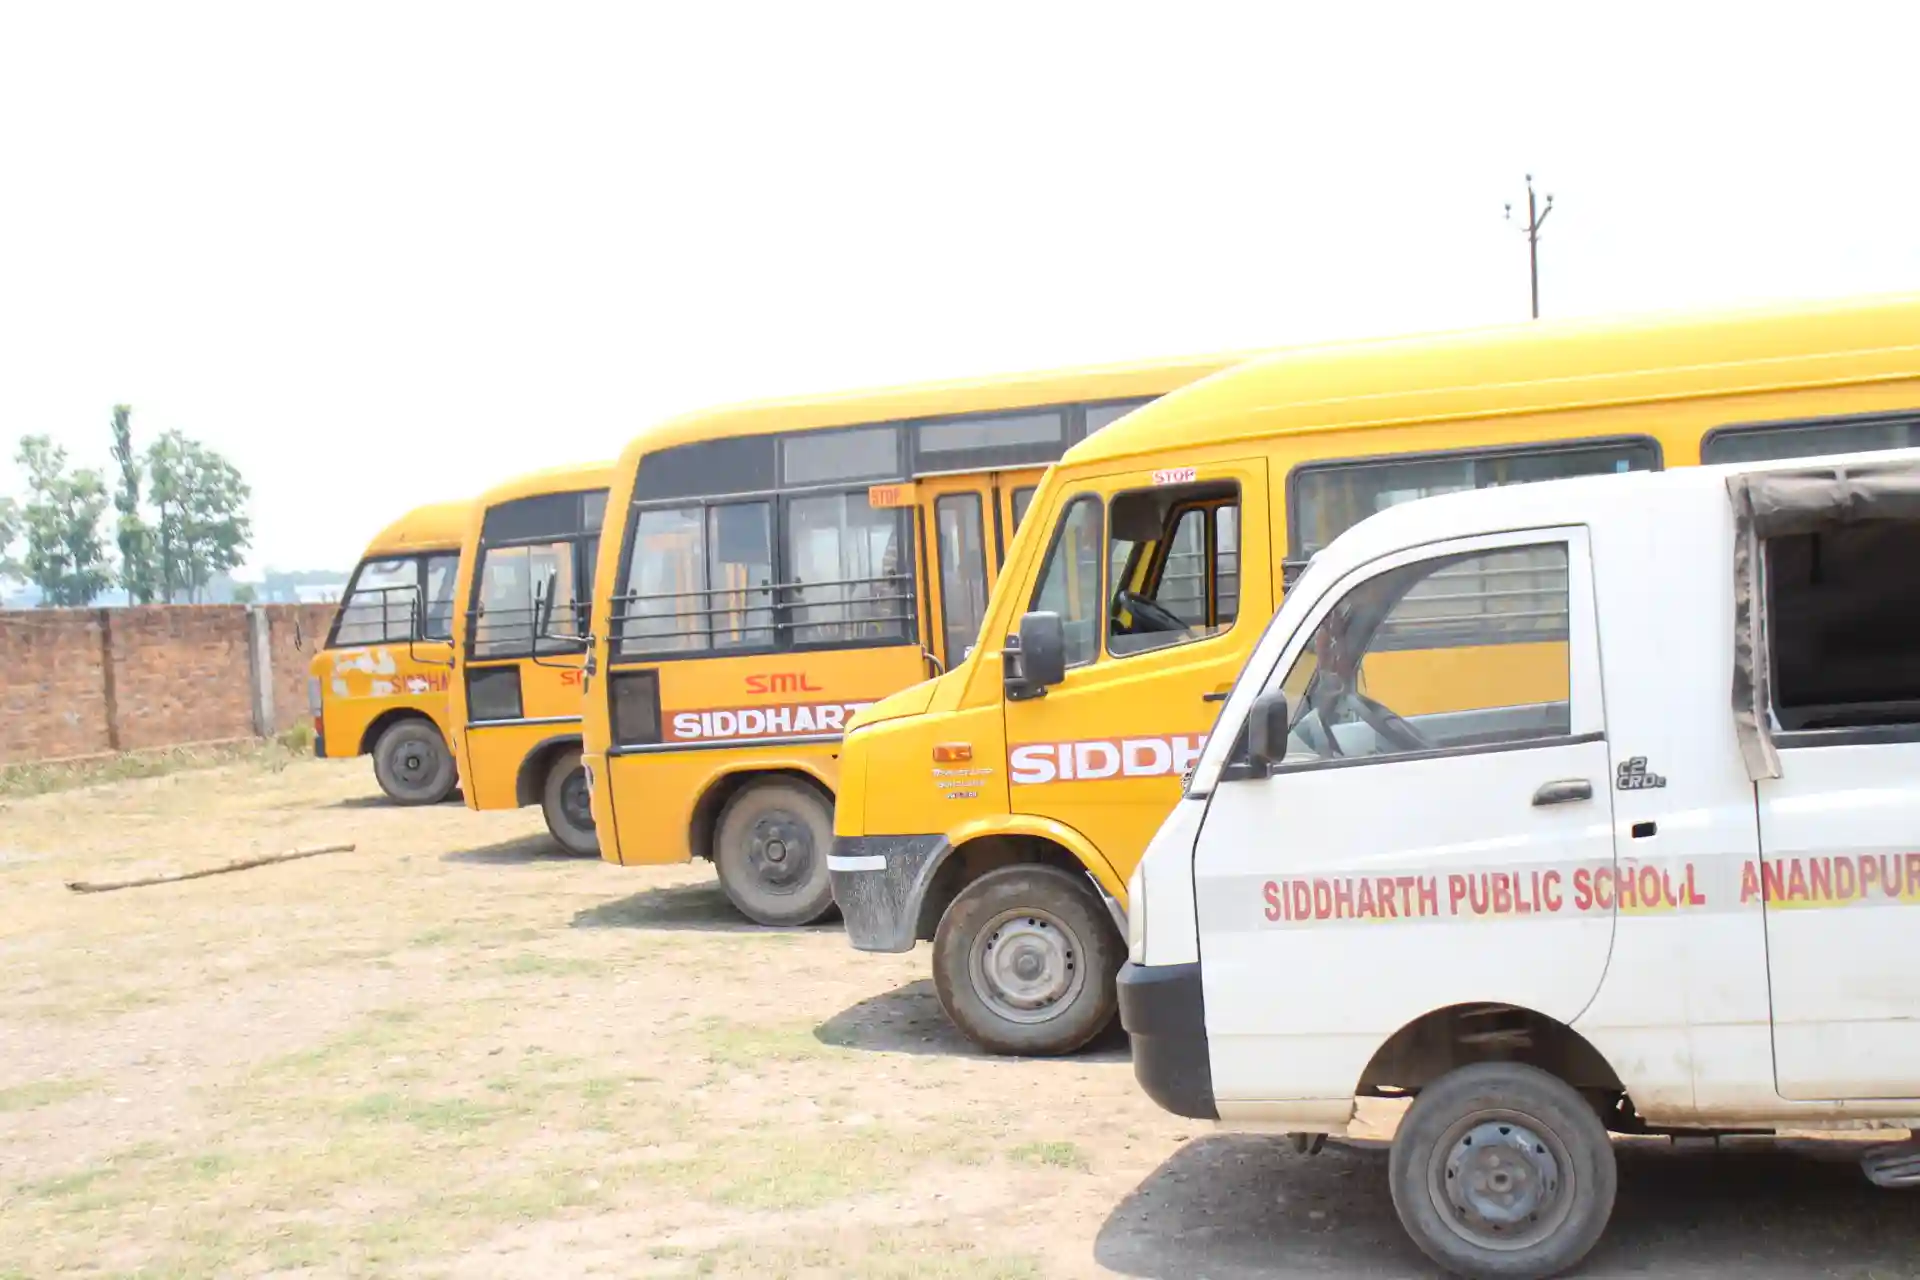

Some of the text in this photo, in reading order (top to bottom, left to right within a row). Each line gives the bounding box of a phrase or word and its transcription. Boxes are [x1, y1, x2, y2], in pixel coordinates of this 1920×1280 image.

[1154, 468, 1194, 483] STOP
[871, 487, 901, 505] STOP
[744, 673, 823, 694] SML
[1263, 876, 1439, 921] SIDDHARTH
[1448, 870, 1562, 915] PUBLIC
[1572, 863, 1706, 910] SCHOOL
